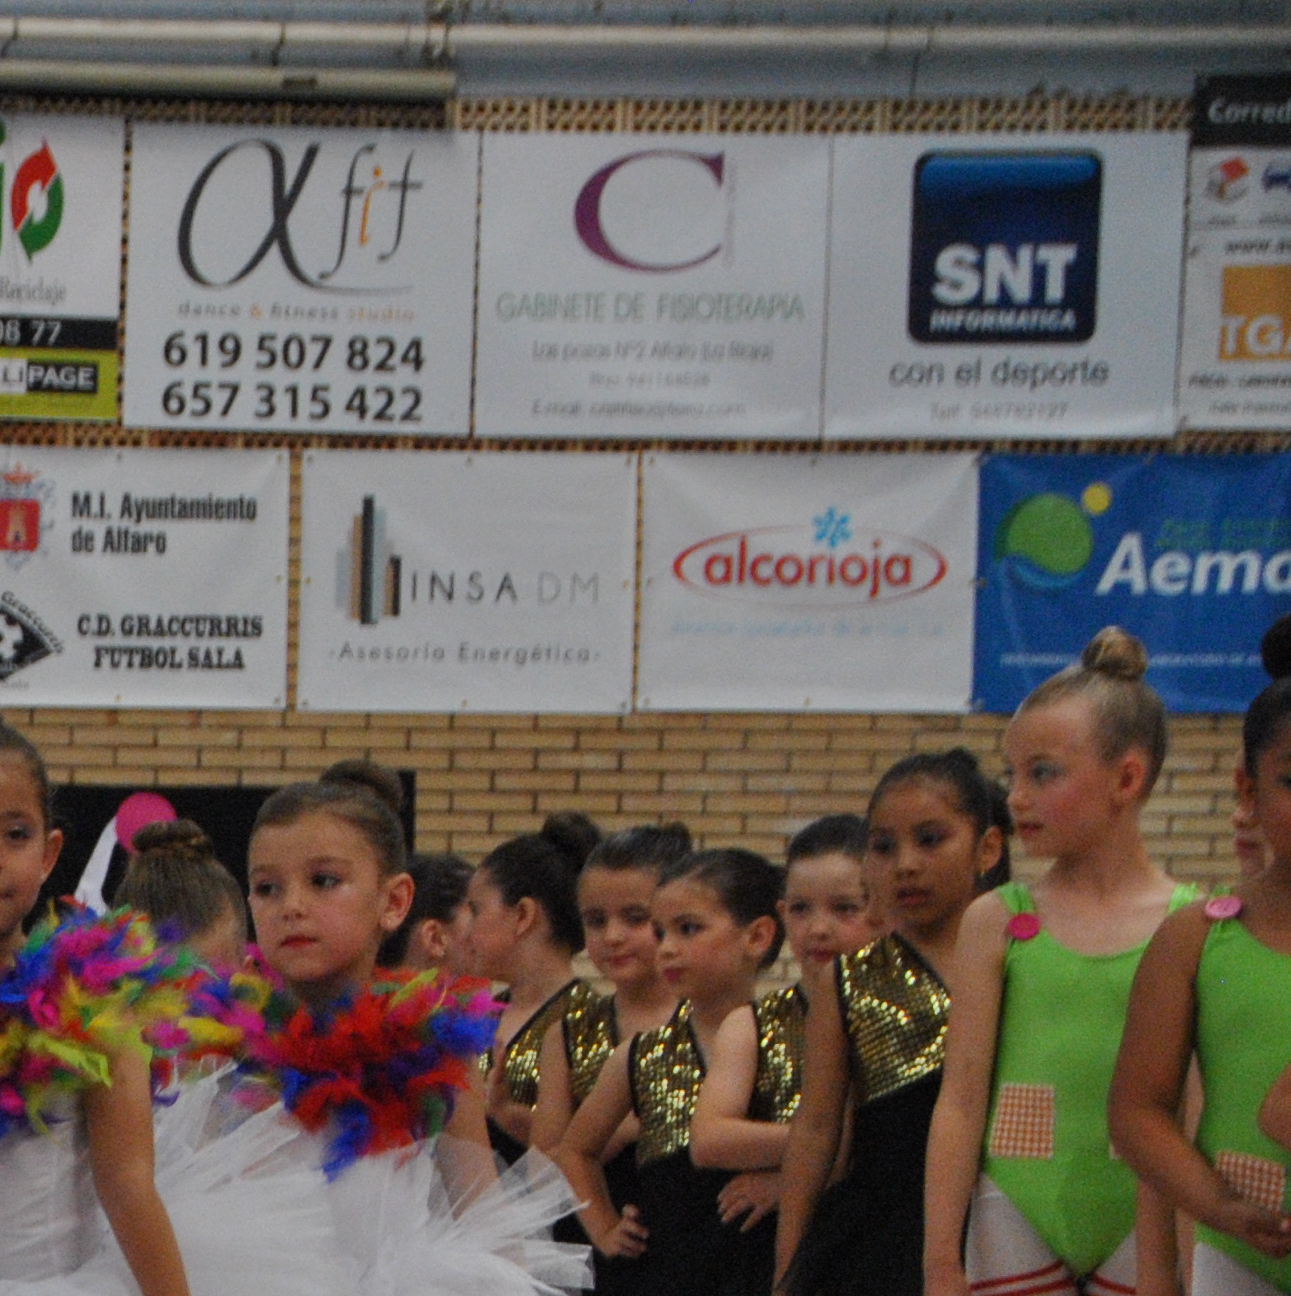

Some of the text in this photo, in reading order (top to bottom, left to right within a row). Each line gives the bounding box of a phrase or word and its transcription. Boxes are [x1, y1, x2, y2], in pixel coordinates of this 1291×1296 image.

[931, 243, 1079, 307] SNT
[178, 300, 241, 318] dance
[270, 301, 339, 320] fitness
[347, 303, 415, 322] studio
[495, 292, 606, 322] GABINETE
[613, 292, 645, 322] DE
[31, 321, 62, 346] 77
[163, 332, 425, 374] 619 507 824
[890, 356, 1110, 391] con el deporte
[161, 381, 424, 422] 657 315 422
[71, 492, 257, 524] M.I. Ayuntamiento
[71, 526, 167, 554] de Alfaro
[703, 534, 913, 598] alcorioja
[411, 571, 599, 604] INSA DM
[77, 614, 263, 639] C.D. GRACCURRIS
[94, 645, 244, 671] FUTBOL SALA
